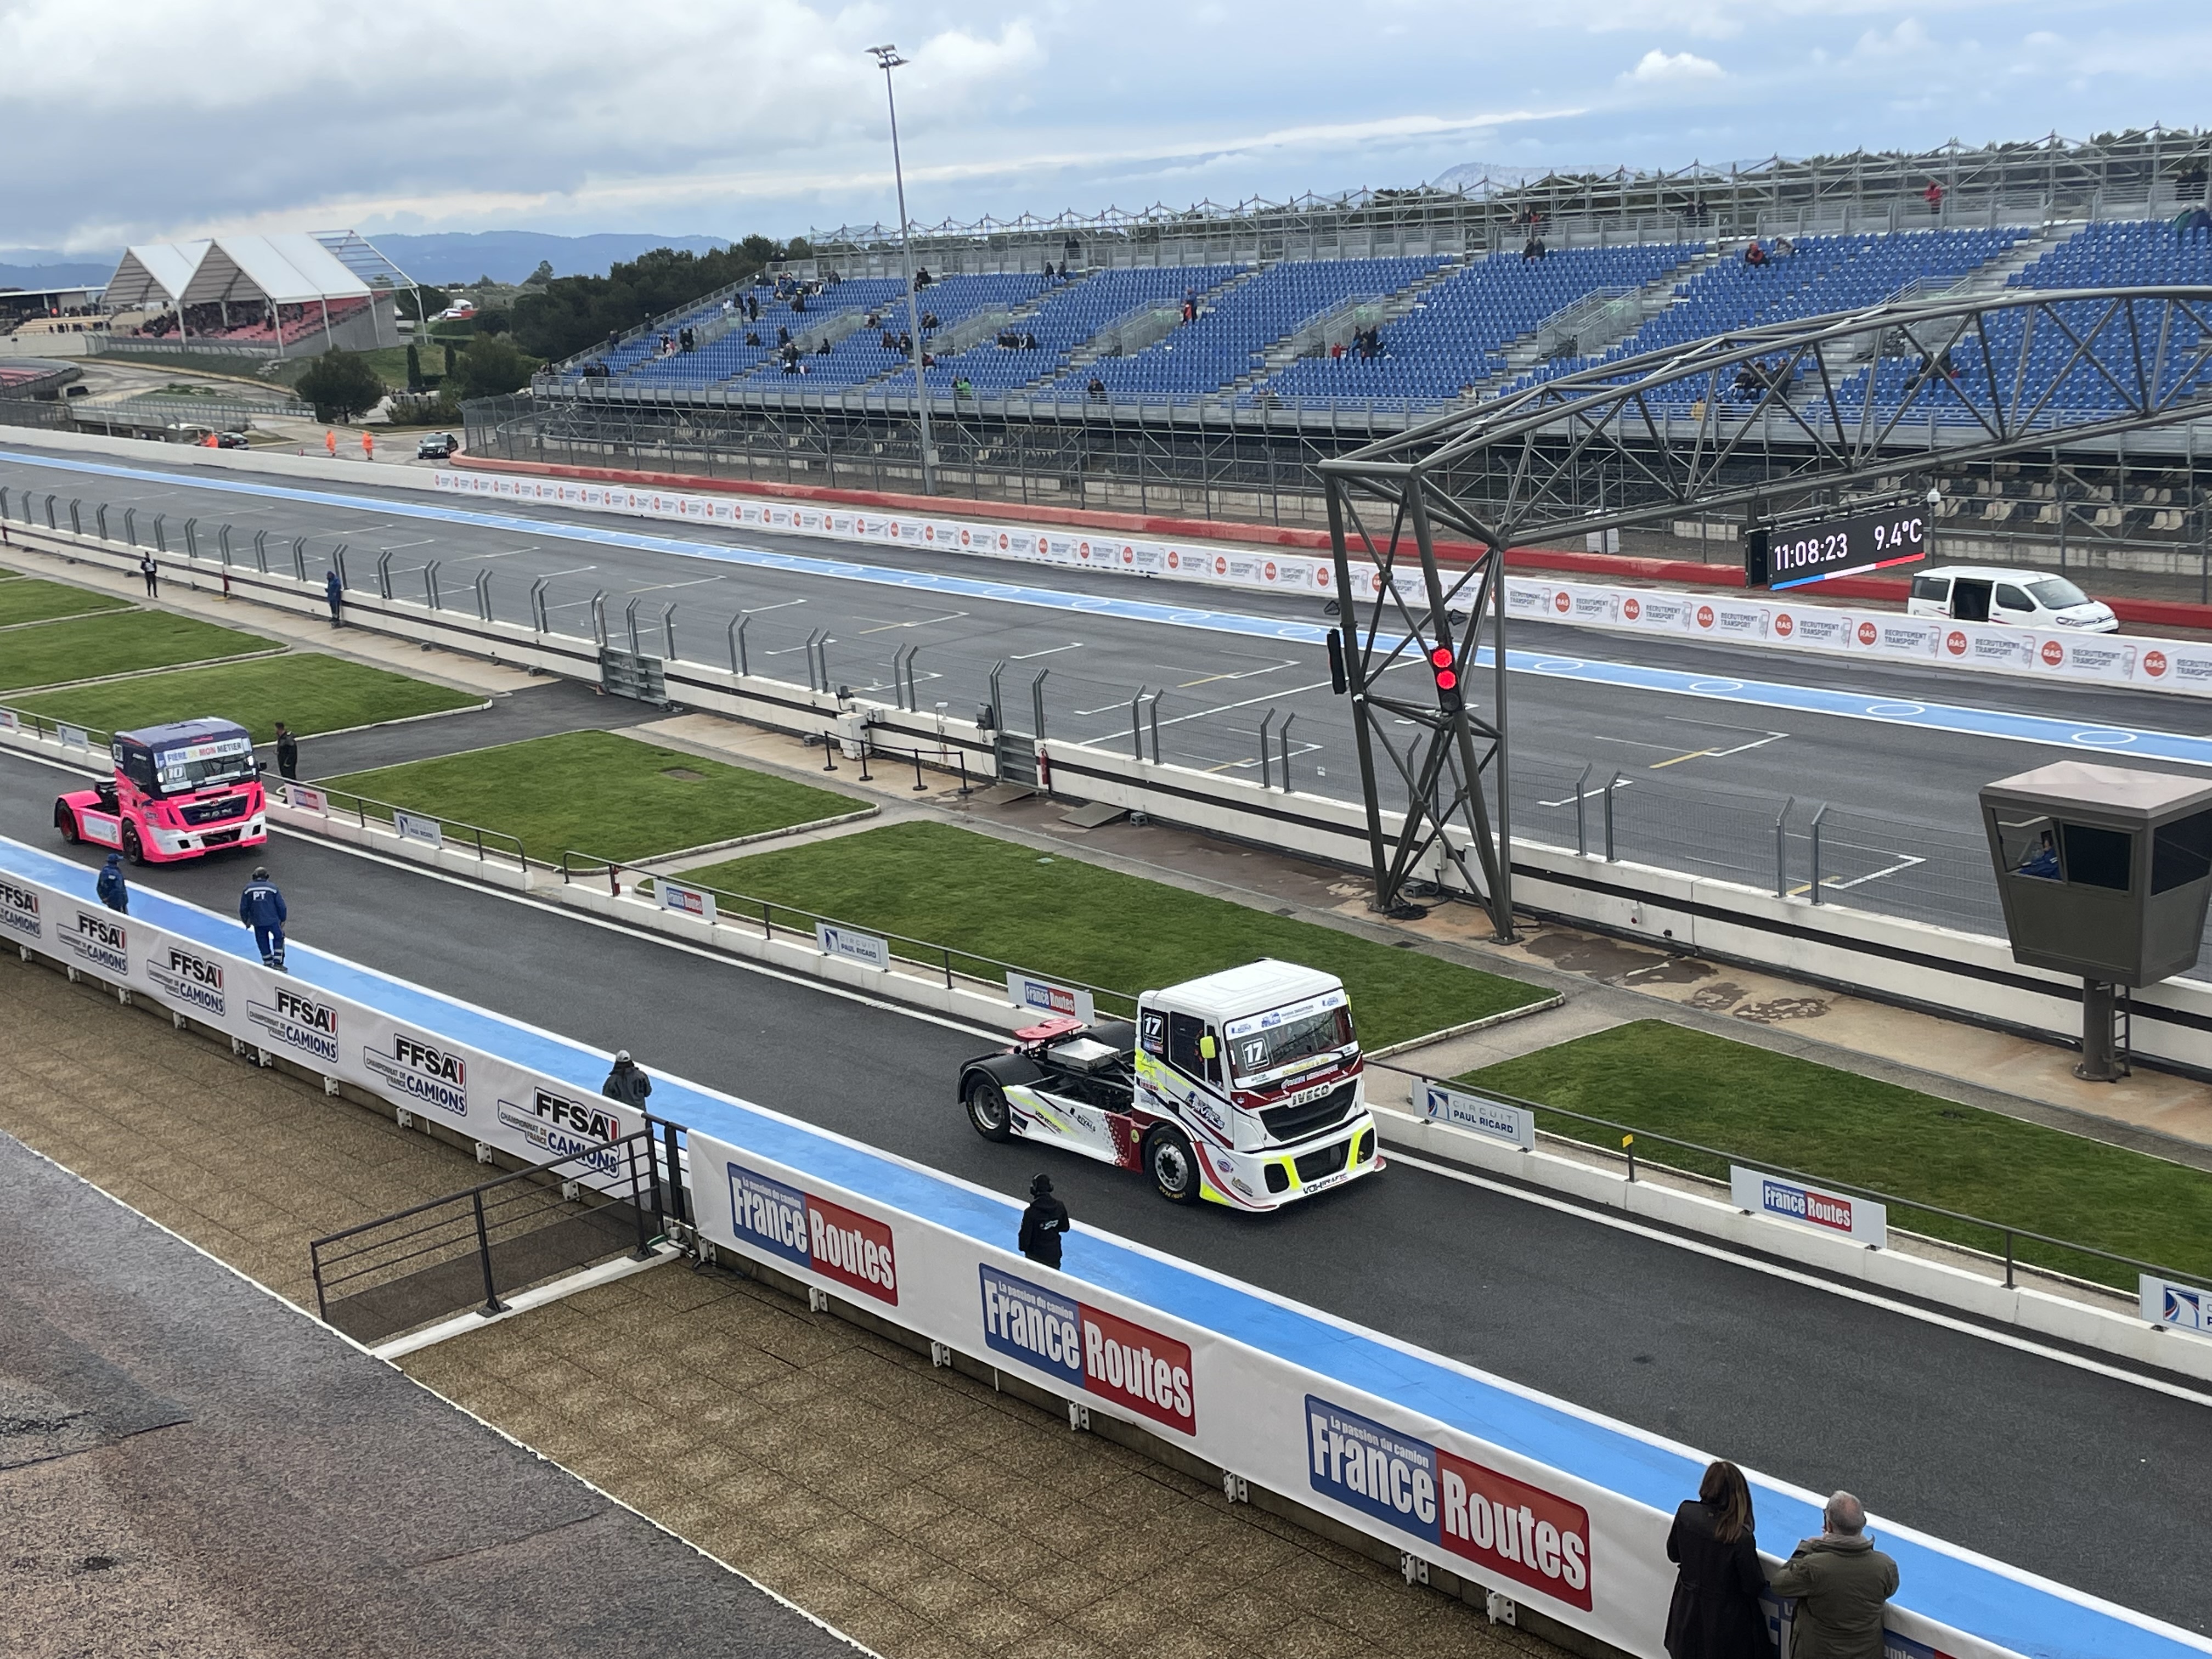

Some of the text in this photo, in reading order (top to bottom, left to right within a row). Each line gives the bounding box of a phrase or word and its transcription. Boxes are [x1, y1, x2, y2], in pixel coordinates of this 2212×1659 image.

[1774, 533, 1848, 571] 11:08:23
[1720, 619, 1751, 628] TRANSPORT
[1776, 621, 1792, 629] RAS
[1800, 620, 1839, 631] RECRUTEMENT
[1800, 628, 1832, 637] TRANSPORT
[1859, 629, 1875, 638] RAS
[1884, 629, 1927, 640] RECRUTEMENT
[1884, 636, 1919, 646] TRANSPORT
[1948, 639, 1965, 647] RAS
[1976, 639, 2020, 650] RECRUTEMENT
[1976, 646, 2012, 656] TRANSPORT
[2043, 649, 2061, 658] RAS
[2072, 657, 2112, 666] TRANSPORT
[2146, 659, 2165, 668] RAS
[199, 746, 216, 757] MON
[167, 767, 183, 779] 10
[253, 891, 266, 900] PT
[5, 911, 41, 934] CAMIONS
[78, 914, 120, 949] FFSA
[87, 944, 126, 972] CAMIONS
[171, 951, 218, 988] FFSA
[180, 983, 223, 1012] CAMIONS
[1026, 985, 1075, 1012] France Routes
[278, 991, 330, 1032] FFSA
[1144, 1017, 1161, 1035] 17
[286, 1026, 336, 1058] CAMIONS
[1244, 1041, 1263, 1064] 17
[396, 1038, 458, 1084] FFSA
[407, 1076, 465, 1112] CAMIONS
[1293, 1085, 1329, 1105] IVECO
[537, 1092, 610, 1142] FFSA
[1453, 1101, 1513, 1122] CIRCUIT
[1454, 1110, 1513, 1133] PAUL RICARD
[501, 1111, 547, 1137] CHAMPIONNAT DE
[527, 1131, 547, 1146] FRANCE
[1764, 1185, 1805, 1215] France
[1807, 1197, 1851, 1227] Routes
[732, 1177, 894, 1290] France Routes
[998, 1280, 1074, 1321] La passion du camion
[984, 1279, 1192, 1418] France Routes
[1330, 1415, 1429, 1469] La passion du camion
[1311, 1413, 1585, 1590] France Routes
